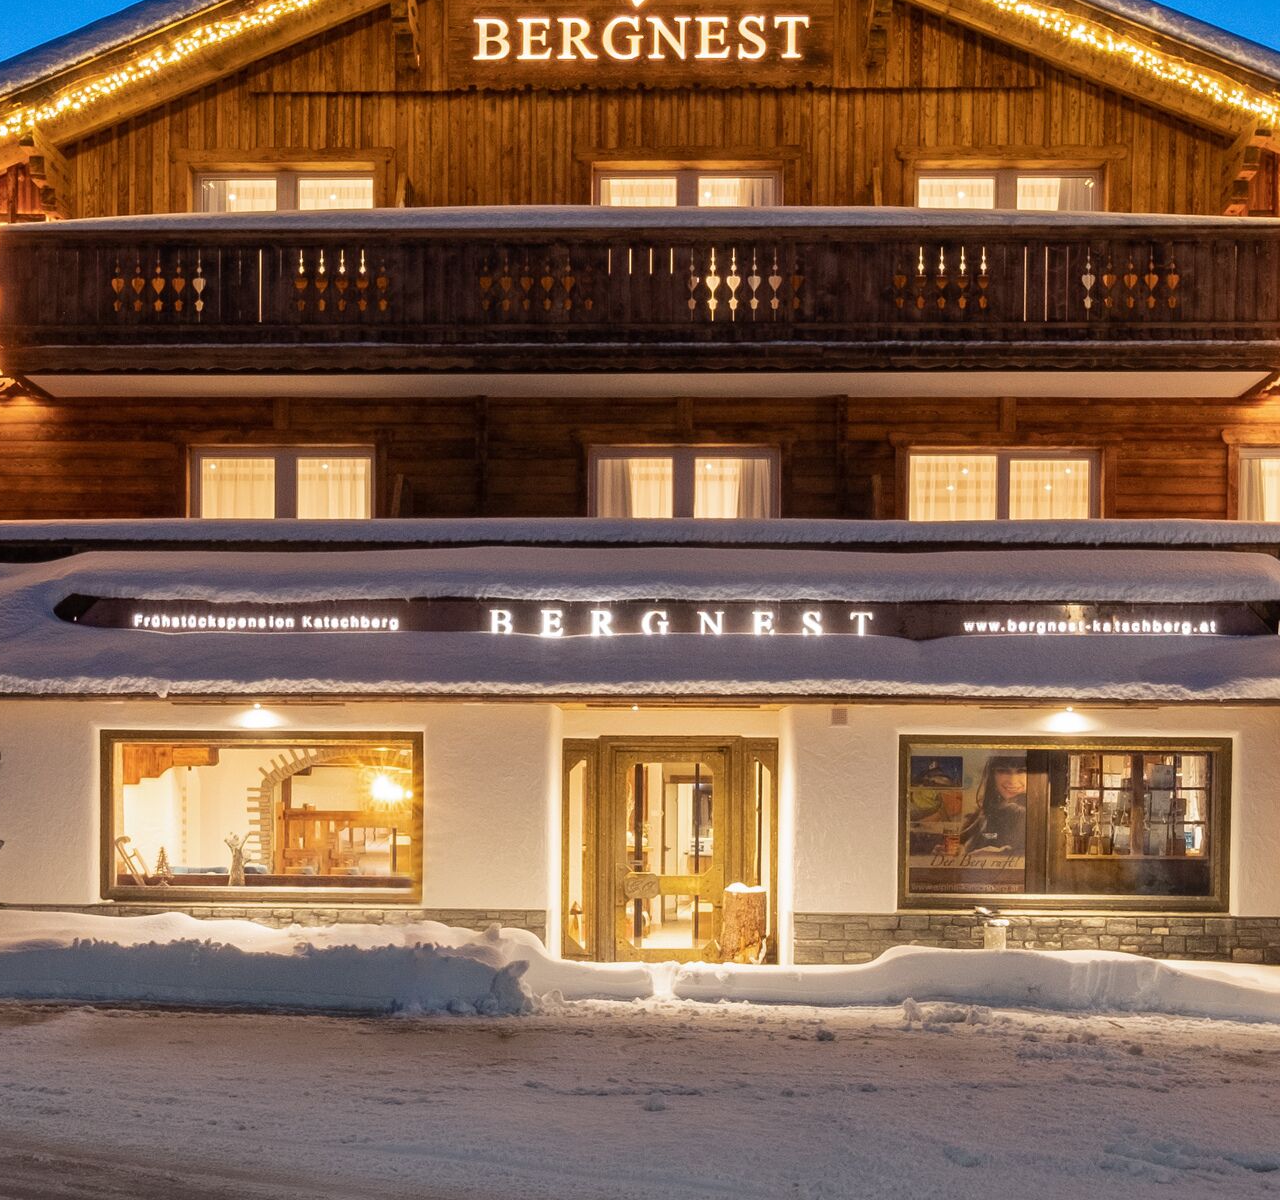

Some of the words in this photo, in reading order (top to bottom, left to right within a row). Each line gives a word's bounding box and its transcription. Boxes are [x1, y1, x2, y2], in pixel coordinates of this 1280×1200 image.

[472, 15, 809, 61] BERGNEST
[301, 614, 400, 631] Katschberg
[488, 608, 874, 637] BERGNEST
[930, 854, 953, 868] Der
